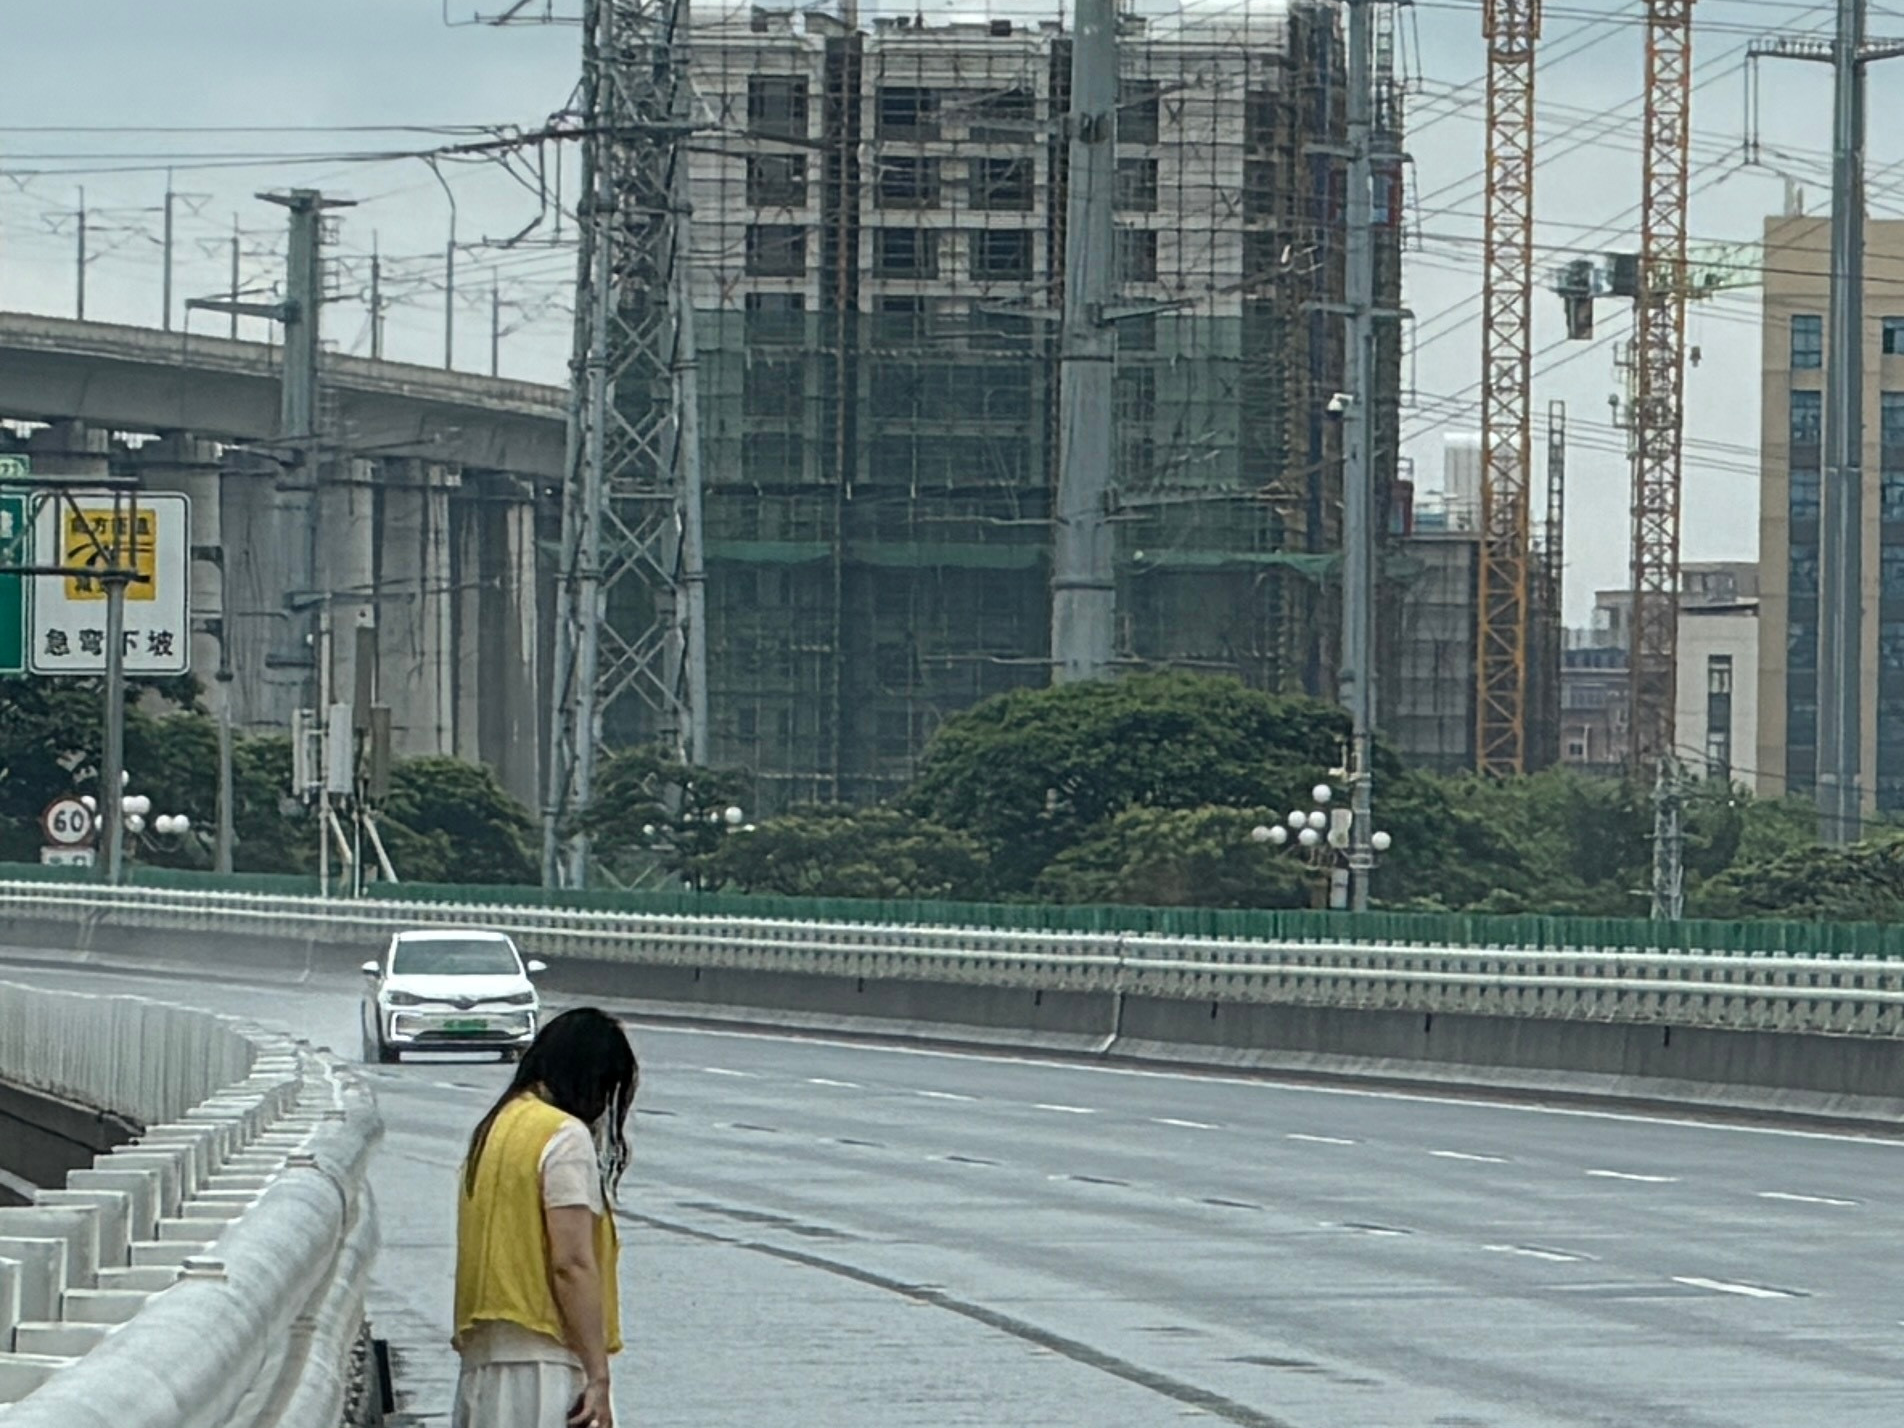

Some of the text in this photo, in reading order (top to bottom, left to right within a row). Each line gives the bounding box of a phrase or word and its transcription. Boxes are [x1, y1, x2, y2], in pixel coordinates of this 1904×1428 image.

[43, 628, 174, 657] 急弯下坡
[53, 809, 84, 833] 60
